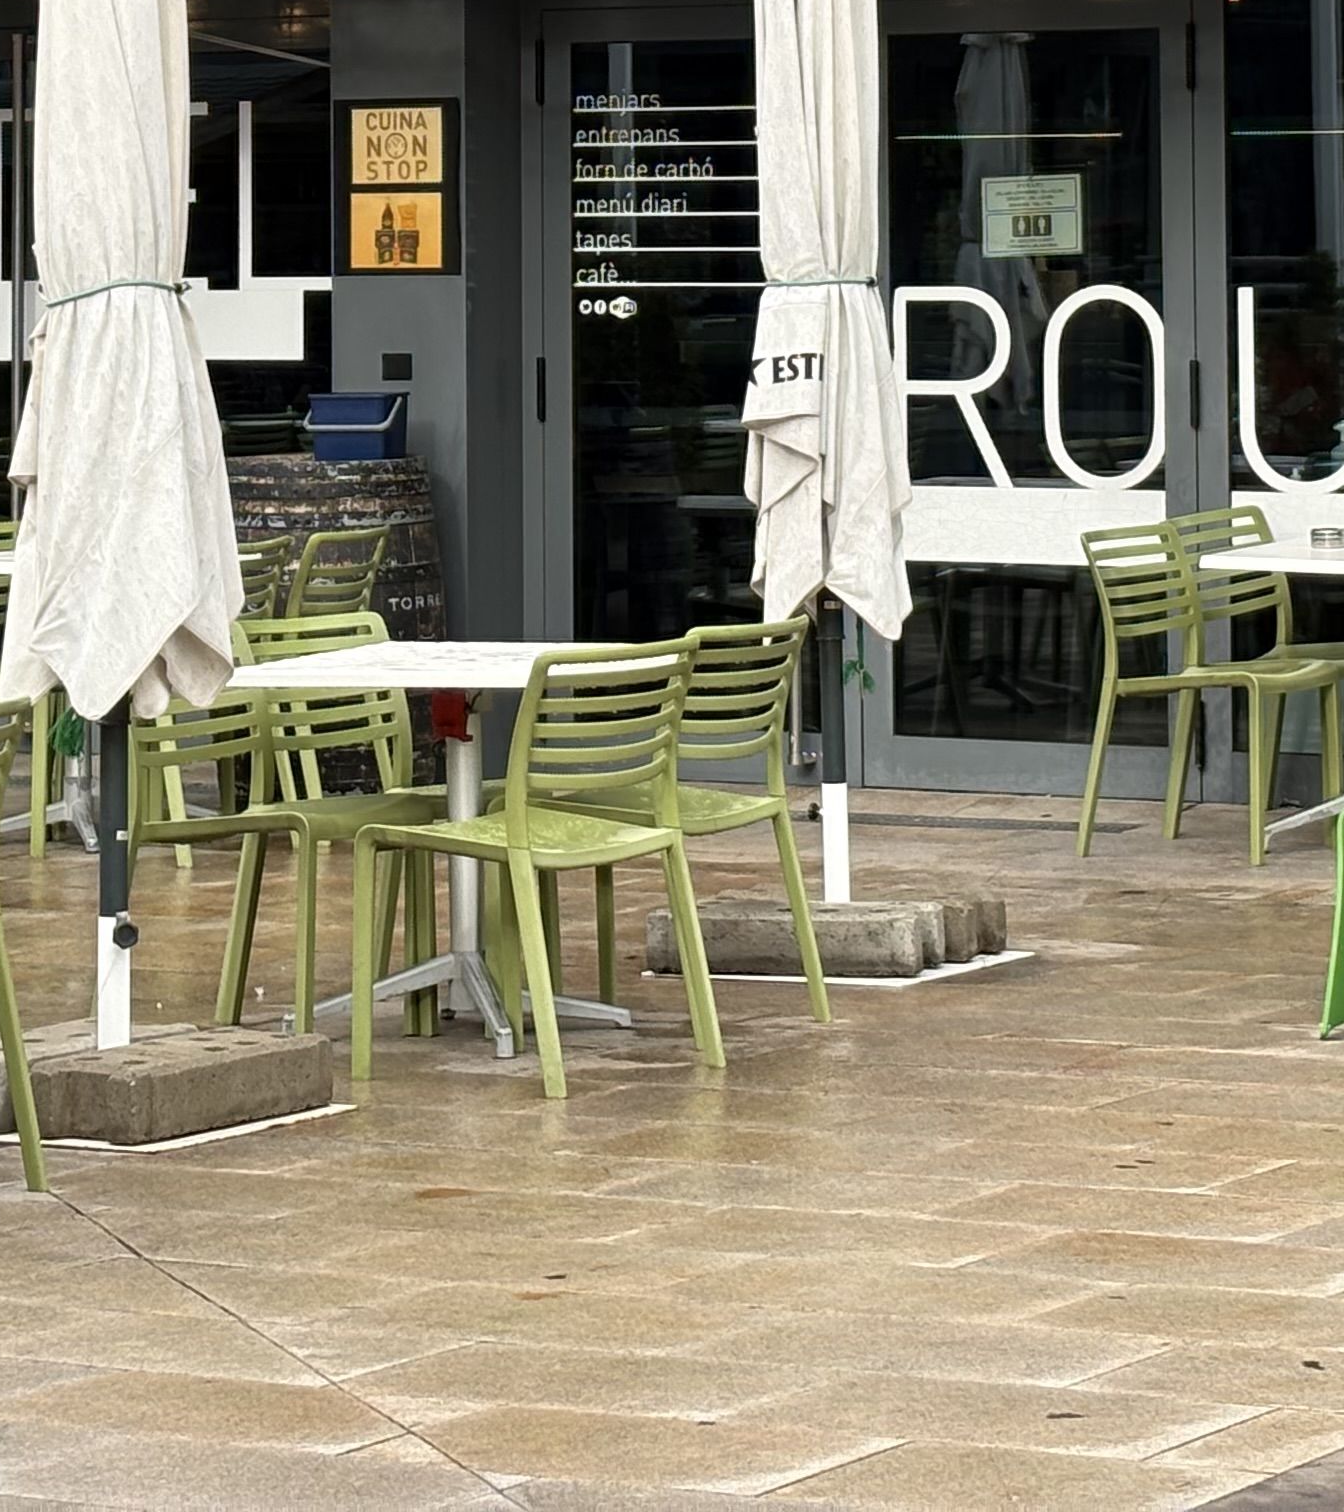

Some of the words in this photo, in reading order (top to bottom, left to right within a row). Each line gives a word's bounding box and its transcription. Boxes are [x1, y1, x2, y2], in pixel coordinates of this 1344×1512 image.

[576, 88, 661, 117] menjars
[365, 110, 428, 131] CUINA
[576, 126, 680, 150] entrepans
[366, 160, 428, 181] STOP
[576, 158, 617, 178] forn
[624, 157, 648, 178] de
[655, 156, 714, 178] carbó
[576, 192, 634, 214] menú
[641, 192, 688, 213] diari
[576, 230, 633, 256] tapes
